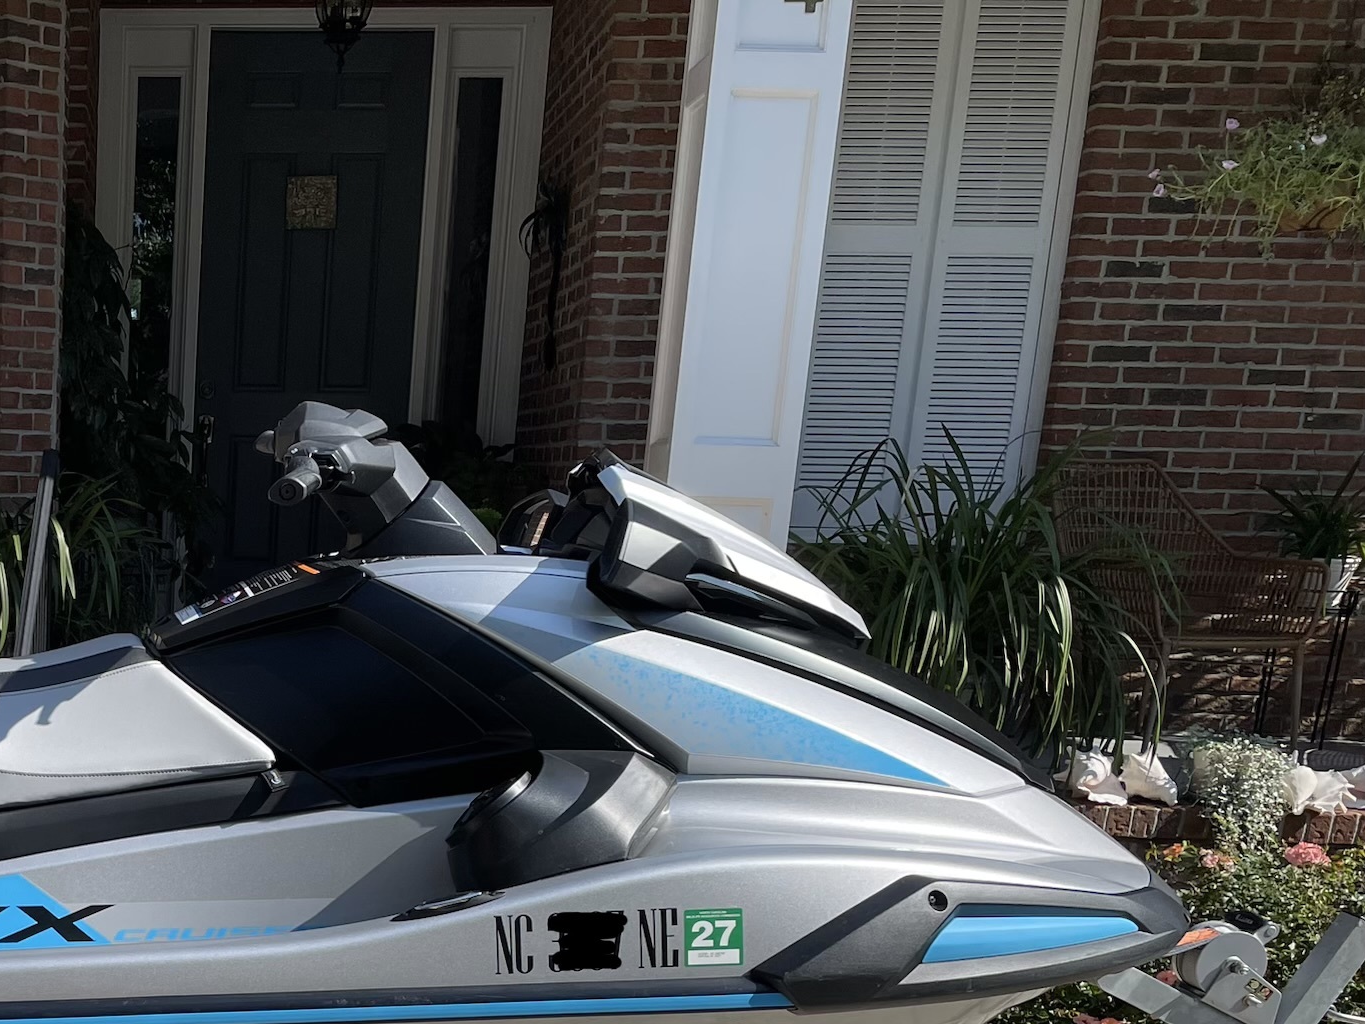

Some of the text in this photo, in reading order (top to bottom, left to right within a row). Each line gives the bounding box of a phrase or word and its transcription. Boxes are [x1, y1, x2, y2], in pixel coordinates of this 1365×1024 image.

[493, 913, 535, 975] NC
[637, 908, 679, 969] NE
[691, 919, 737, 948] 27
